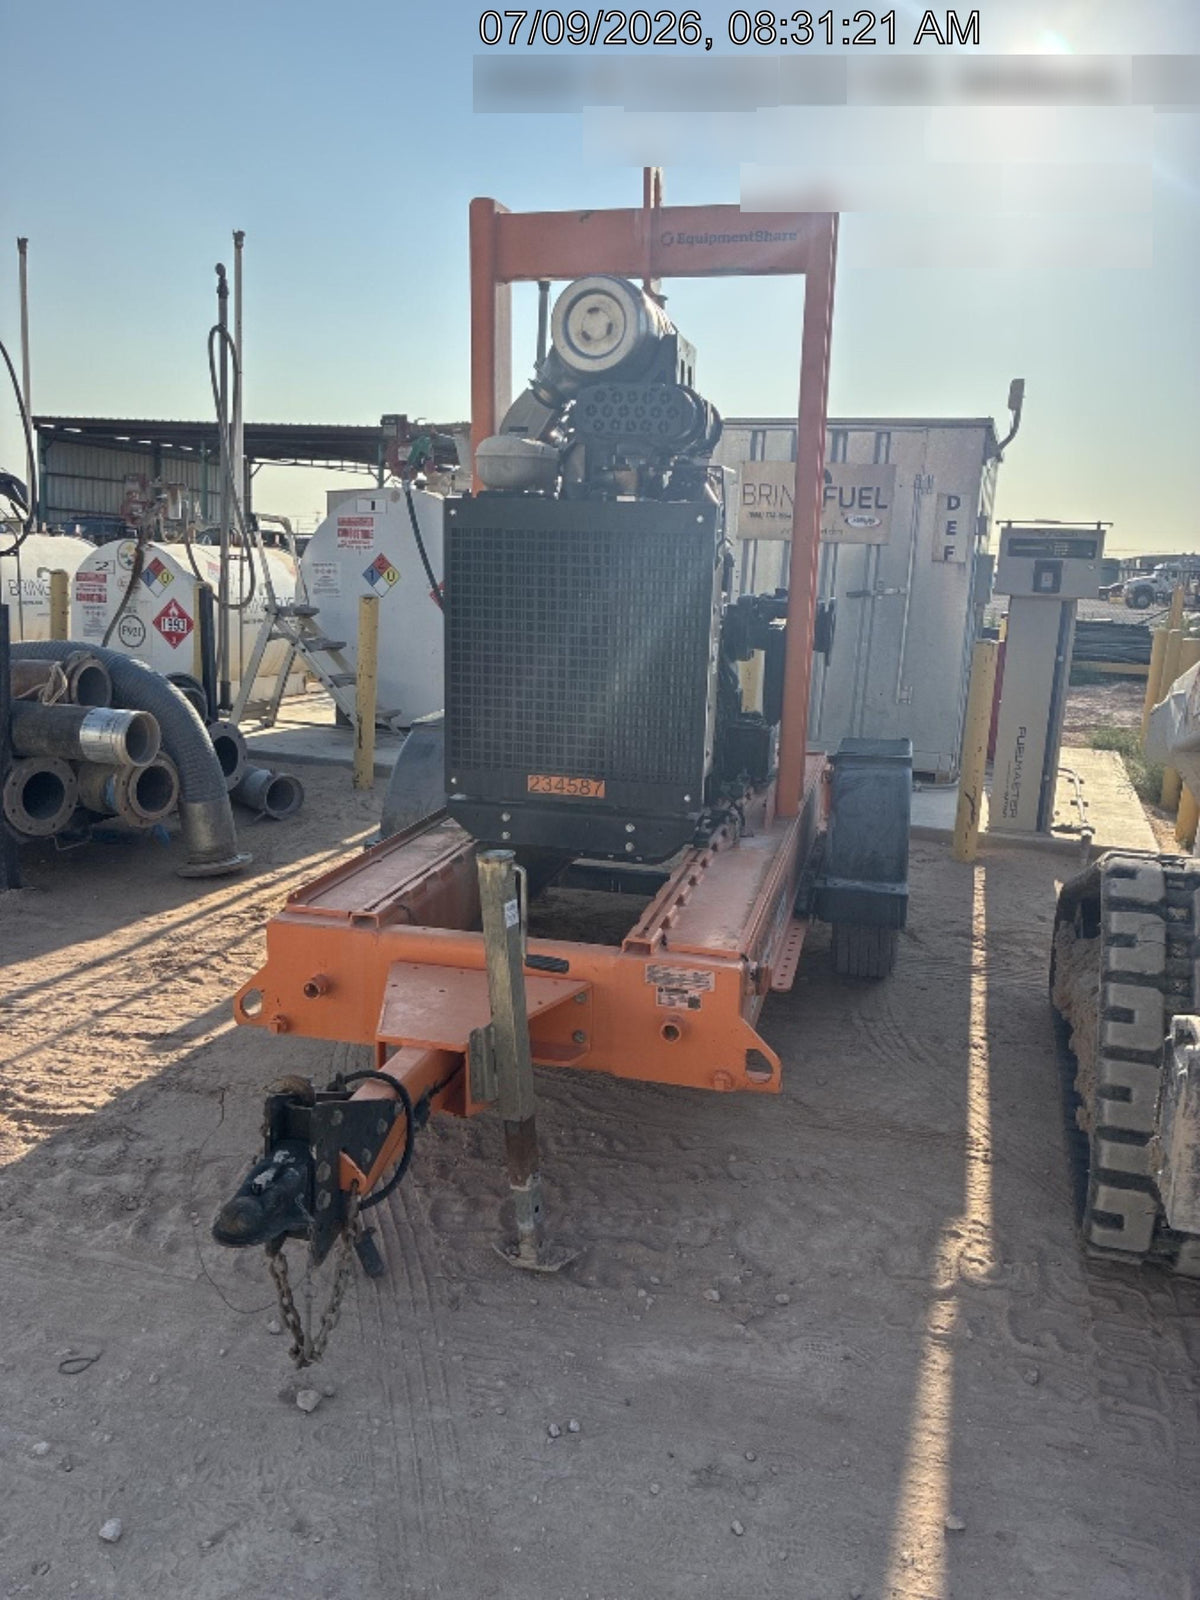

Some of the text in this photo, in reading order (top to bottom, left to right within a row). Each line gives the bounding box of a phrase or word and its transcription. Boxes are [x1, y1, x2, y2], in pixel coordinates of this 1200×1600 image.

[676, 230, 798, 247] EquipmentShare
[743, 483, 889, 510] BRIN FUEL
[529, 776, 604, 796] 234587
